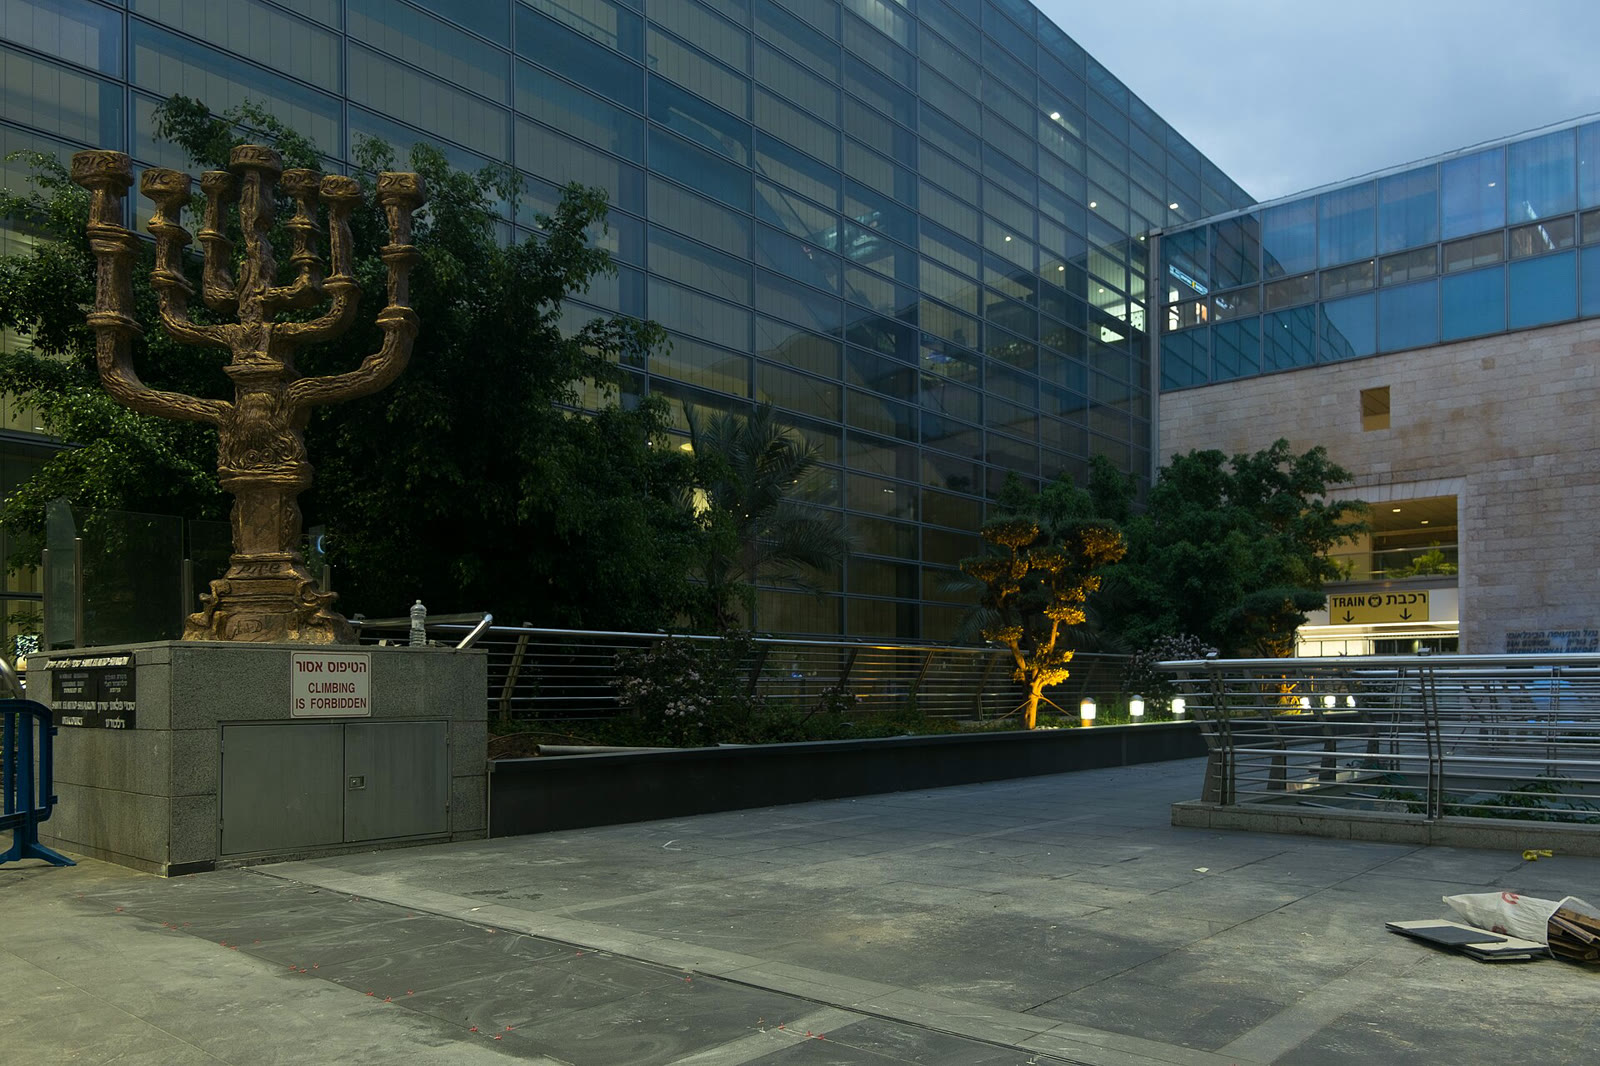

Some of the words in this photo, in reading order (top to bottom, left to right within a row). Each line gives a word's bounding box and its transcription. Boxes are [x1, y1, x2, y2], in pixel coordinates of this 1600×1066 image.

[1332, 596, 1365, 608] TRAIN
[1386, 593, 1426, 605] רכבת
[296, 661, 323, 672] אסור
[327, 661, 367, 673] הטיפוס
[308, 682, 355, 693] CLIMBING
[295, 698, 306, 709] IS
[310, 697, 367, 709] FORBIDDEN
